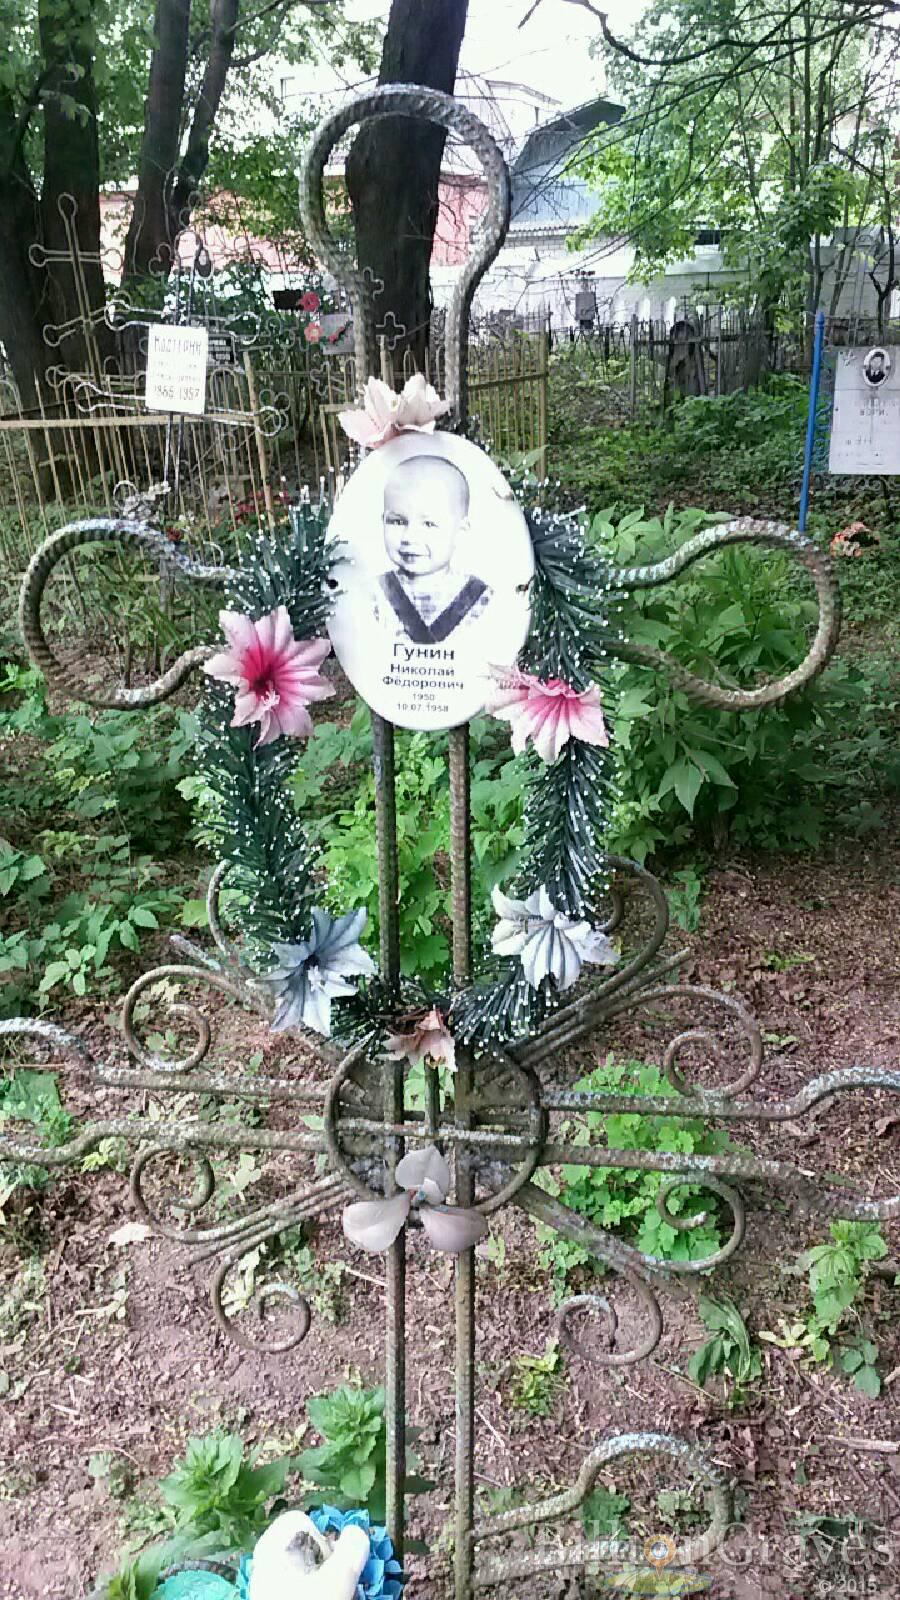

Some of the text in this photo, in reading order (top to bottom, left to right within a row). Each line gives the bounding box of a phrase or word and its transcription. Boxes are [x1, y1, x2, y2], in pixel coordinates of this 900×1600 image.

[393, 643, 455, 661] Гунин
[390, 664, 455, 677] Николай
[382, 675, 464, 690] Фёдорович
[412, 693, 436, 702] 1950
